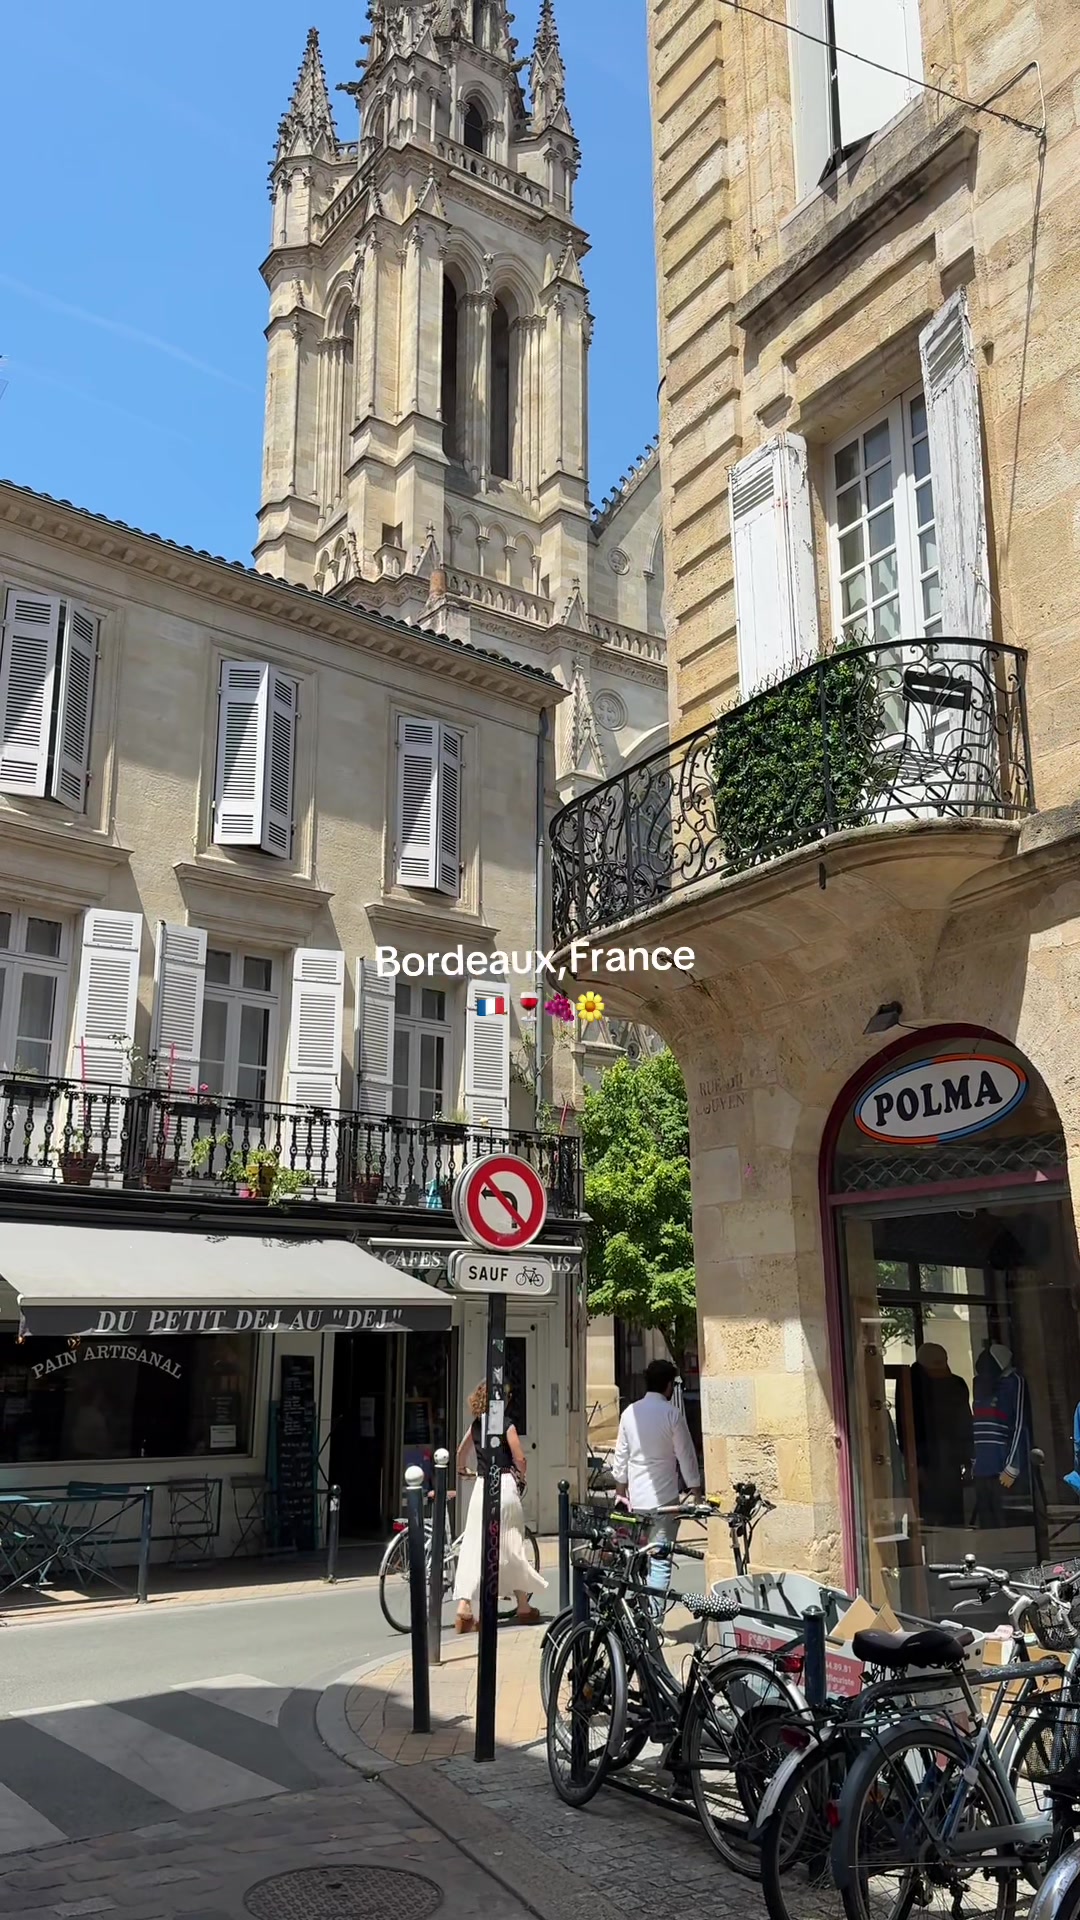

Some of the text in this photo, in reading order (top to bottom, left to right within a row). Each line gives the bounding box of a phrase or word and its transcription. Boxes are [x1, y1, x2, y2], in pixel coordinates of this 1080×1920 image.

[873, 1070, 1003, 1127] POLMA
[468, 1265, 510, 1282] SAUF
[96, 1310, 138, 1333] DU
[147, 1309, 227, 1332] PETIT
[234, 1309, 283, 1330] DEJ
[288, 1309, 324, 1330] AU
[31, 1345, 182, 1380] PAIN ARTISANAL
